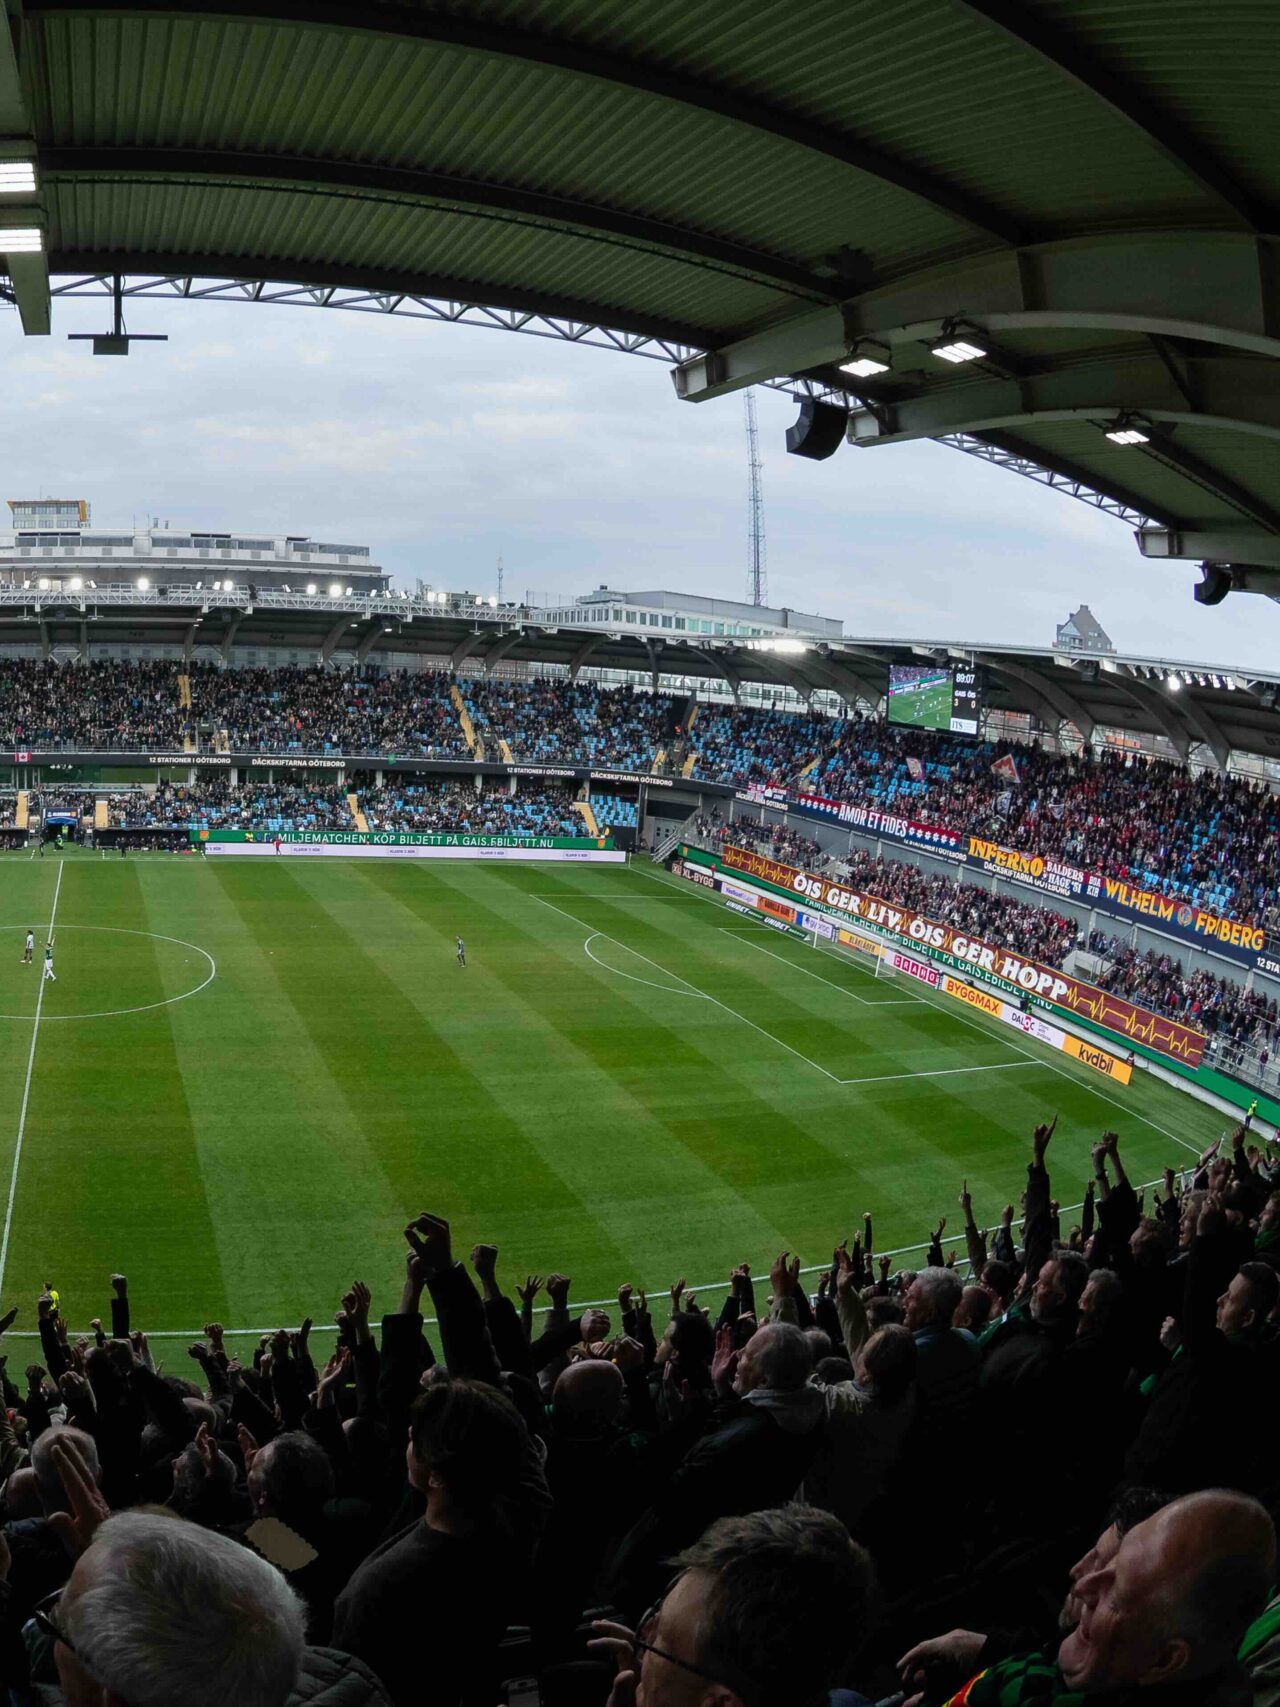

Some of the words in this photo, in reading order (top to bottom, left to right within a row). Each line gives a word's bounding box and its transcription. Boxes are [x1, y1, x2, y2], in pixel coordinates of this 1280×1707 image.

[956, 674, 975, 683] 89:07
[954, 698, 959, 707] 3
[971, 700, 976, 709] 0
[195, 756, 231, 765] GÖTEBORG
[252, 758, 307, 767] DÄCKSKIFTARNA
[307, 759, 346, 768] GÖTEBORG
[590, 772, 639, 783] DÄCKSKIFTARNA
[640, 775, 673, 787] GÖTEBORG
[838, 804, 867, 826] AMOR
[867, 811, 880, 830] ET
[880, 814, 908, 838] FIDES
[373, 833, 395, 844] KÖP
[400, 835, 442, 845] BILJETT
[446, 835, 458, 846] PÅ
[683, 867, 714, 888] XL-BYGG
[1047, 861, 1084, 883] BALDERS
[1048, 873, 1071, 890] HAGE
[725, 899, 751, 915] UNIBET
[1105, 878, 1175, 922] WILHELM
[763, 916, 790, 933] UNIBET
[793, 872, 821, 900] ÖIS
[827, 888, 860, 913] GER
[866, 902, 902, 933] LIV,
[909, 916, 945, 949] ÖIS
[952, 937, 995, 971] GER
[1001, 954, 1069, 1002] HOPP
[894, 955, 937, 984] CRAMO
[1257, 956, 1265, 968] 12
[946, 980, 1000, 1013] BYGGMAX
[1011, 1012, 1035, 1031] DALOC
[1078, 1043, 1114, 1074] kvdbil
